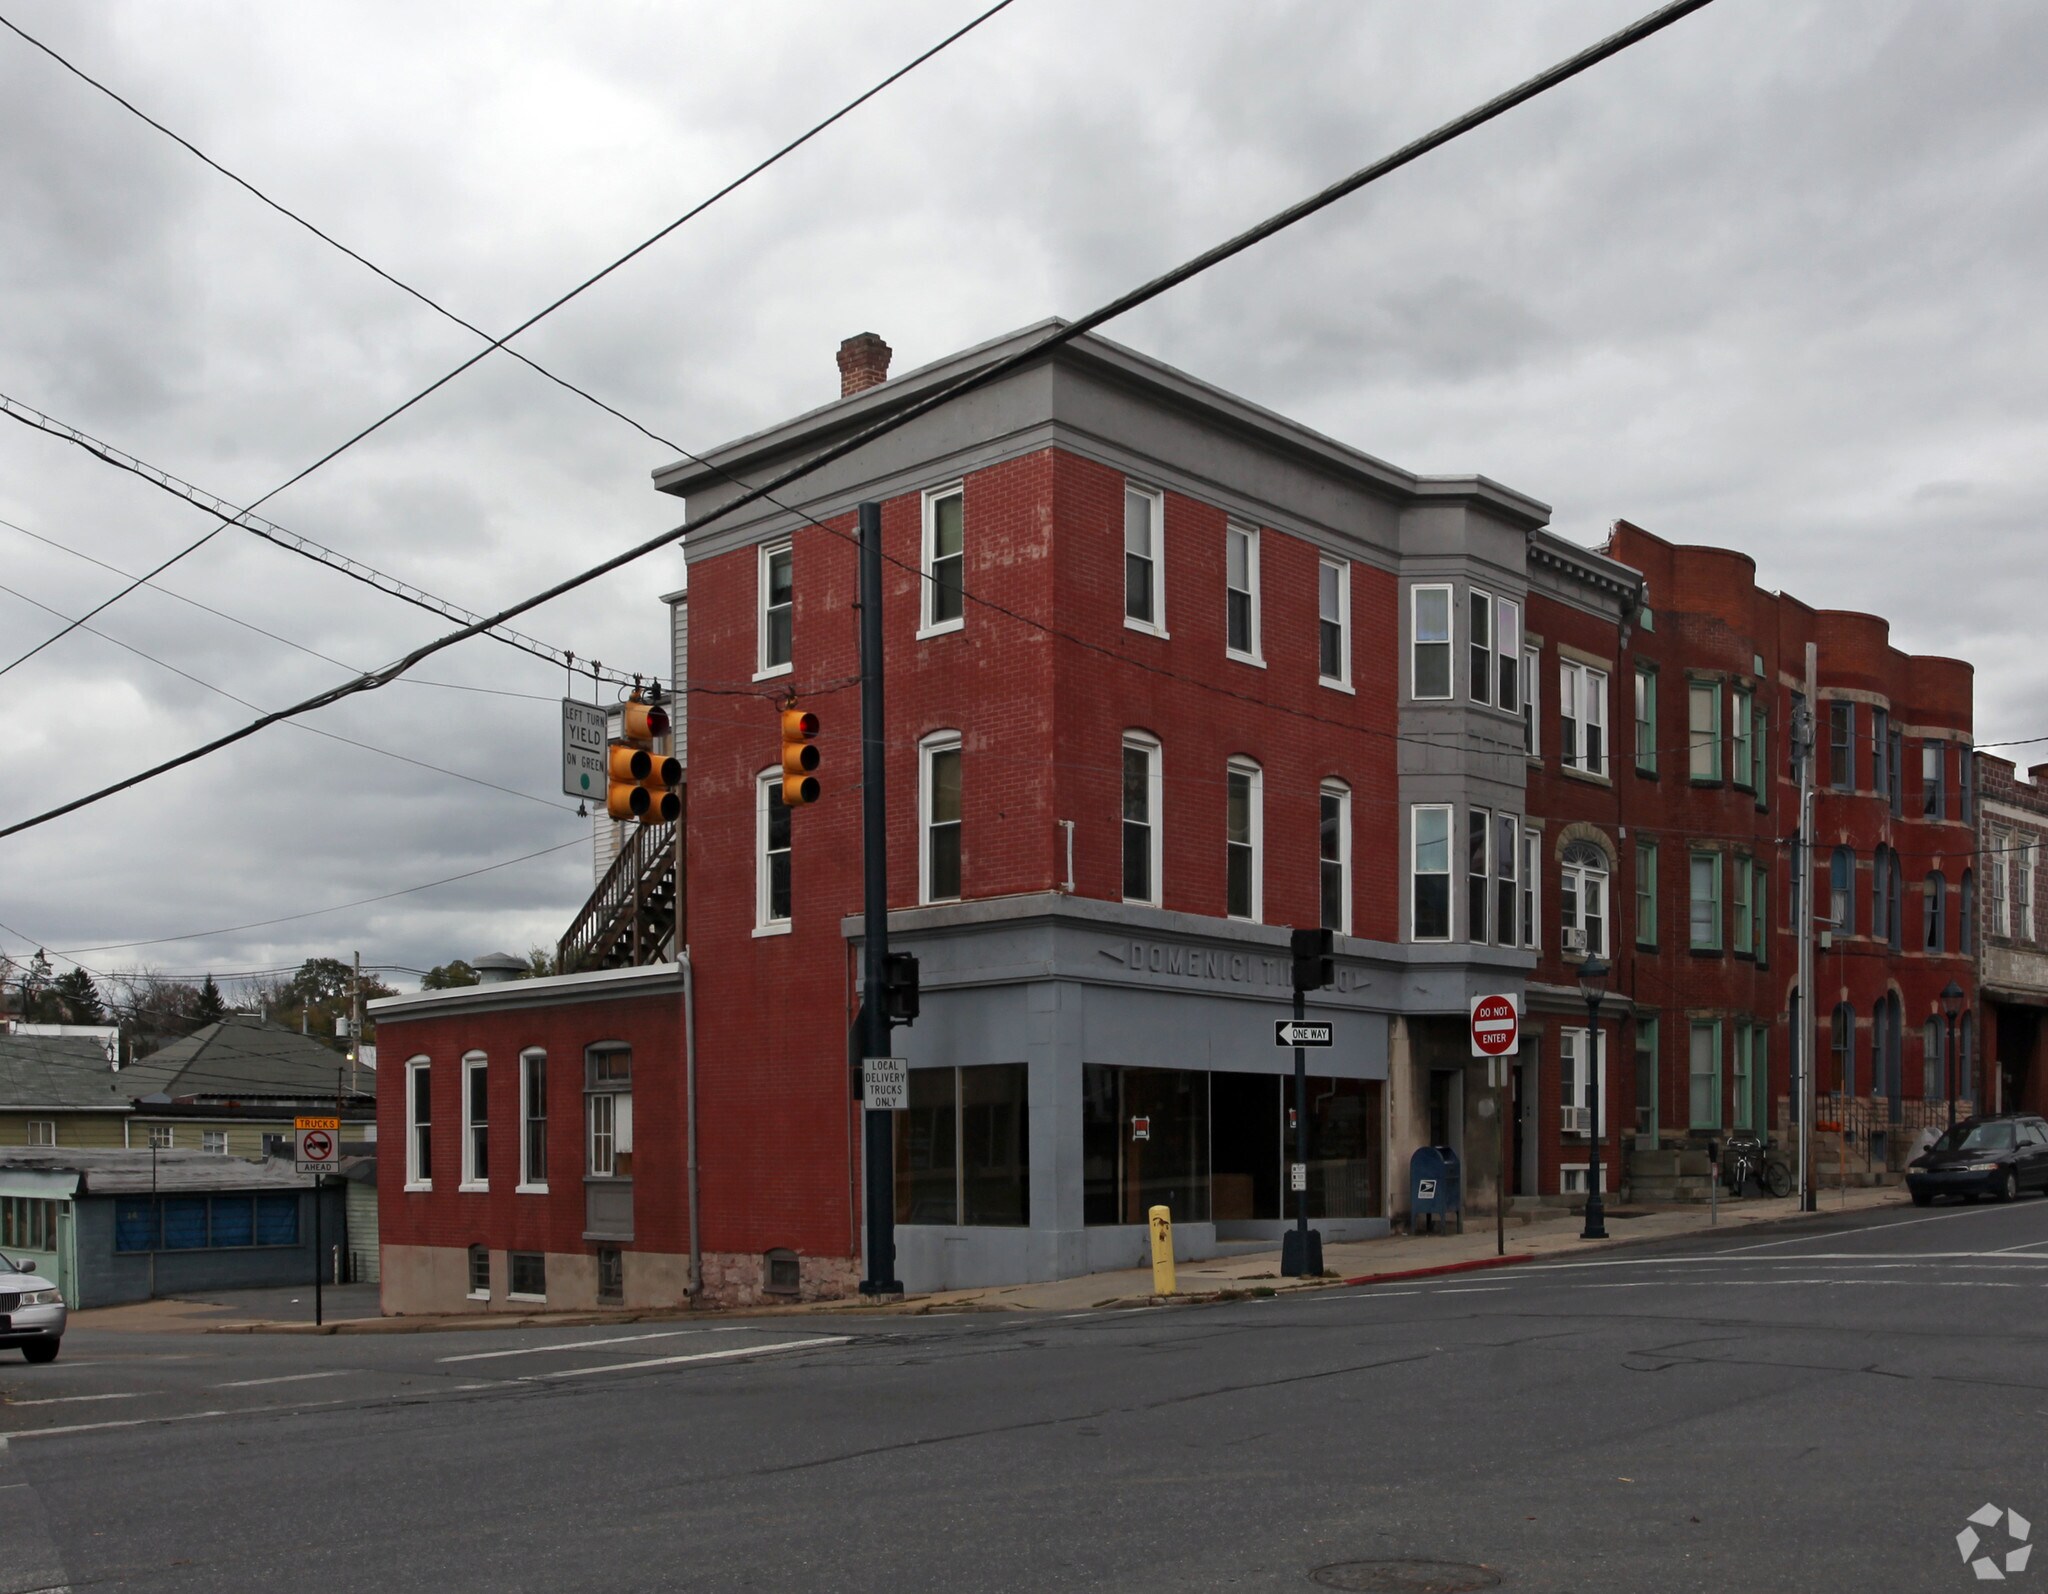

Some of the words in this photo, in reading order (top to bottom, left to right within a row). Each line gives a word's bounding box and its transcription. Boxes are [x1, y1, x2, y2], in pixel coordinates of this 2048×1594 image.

[565, 707, 583, 723] LEFT
[586, 712, 605, 728] TURN
[569, 724, 601, 745] YIELD
[566, 752, 577, 766] ON
[581, 756, 604, 772] GREEN
[1130, 941, 1253, 984] DOMENICI
[1480, 1008, 1491, 1018] DO
[1493, 1006, 1508, 1017] NOT
[1292, 1028, 1308, 1039] ONE
[1310, 1029, 1327, 1039] WAY
[1482, 1033, 1507, 1044] ENTER
[872, 1060, 899, 1071] LOCAL
[865, 1072, 906, 1083] DELIVERY
[870, 1084, 903, 1095] TRUCKS
[875, 1097, 897, 1107] ONLY
[300, 1119, 335, 1128] TRUCKS
[304, 1163, 332, 1171] AHEAD
